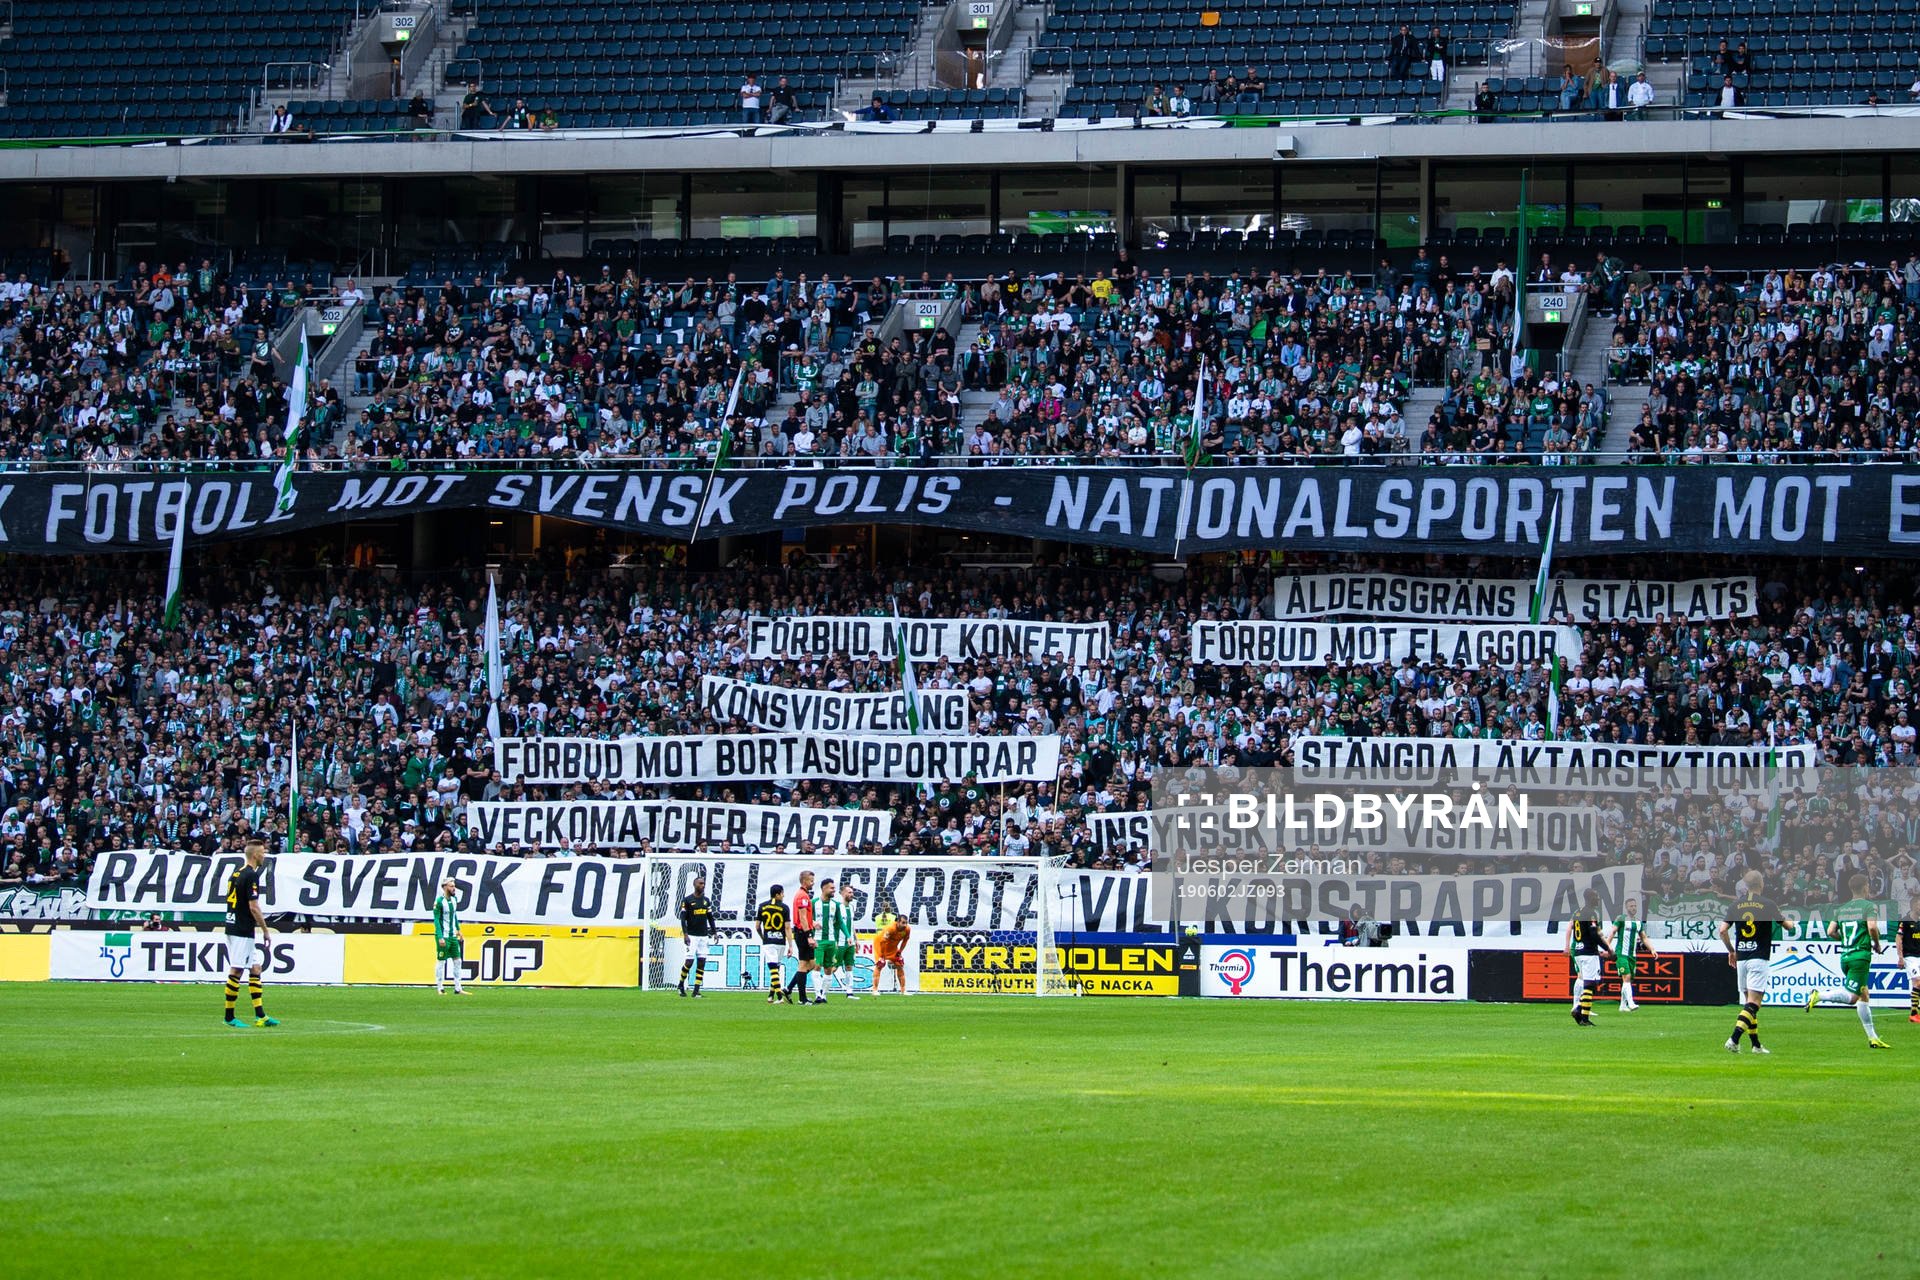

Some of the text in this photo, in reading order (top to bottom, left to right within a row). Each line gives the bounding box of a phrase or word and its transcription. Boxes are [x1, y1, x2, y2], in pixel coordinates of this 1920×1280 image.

[395, 17, 413, 26] 302
[972, 4, 990, 13] 301
[321, 311, 340, 320] 202
[919, 304, 936, 314] 201
[1543, 297, 1563, 307] 240
[328, 474, 466, 512] MOT
[488, 474, 748, 526] SVENSK
[773, 475, 961, 519] POLIS
[1045, 475, 1675, 543] NATIONALSPORTEN
[1713, 475, 1851, 542] MOT
[1286, 576, 1516, 617] ÅLDERSGRÄNS
[1583, 579, 1748, 618] STÅPLATS
[750, 616, 1108, 661] FÖRBUD MOT KONFETTI
[1199, 621, 1557, 665] FÖRBUD MOT FLAGGOR
[707, 679, 964, 731] KÖNSVISITERNG
[502, 737, 1036, 779] FÖRBUD MOT BORTASUPPORTRAR
[1302, 737, 1806, 789] STÄNGDA LÄKTARSEKTIONER
[478, 805, 880, 849] VECKOMATCHER DAGTID
[1094, 808, 1592, 851] INSYNSSKYDDAD VISITATION
[98, 849, 277, 906] RÄDDA
[298, 857, 522, 915] SVENSK
[761, 911, 783, 930] 20
[1741, 911, 1756, 938] 3
[1841, 920, 1858, 947] 17
[926, 945, 1173, 972] HYRPOOLEN
[1210, 963, 1244, 973] Thermia
[1604, 960, 1674, 975] ORK
[1101, 980, 1154, 991] NACKA
[1270, 952, 1455, 994] Thermia
[1767, 972, 1847, 989] produkter
[1596, 983, 1672, 993] YSEM
